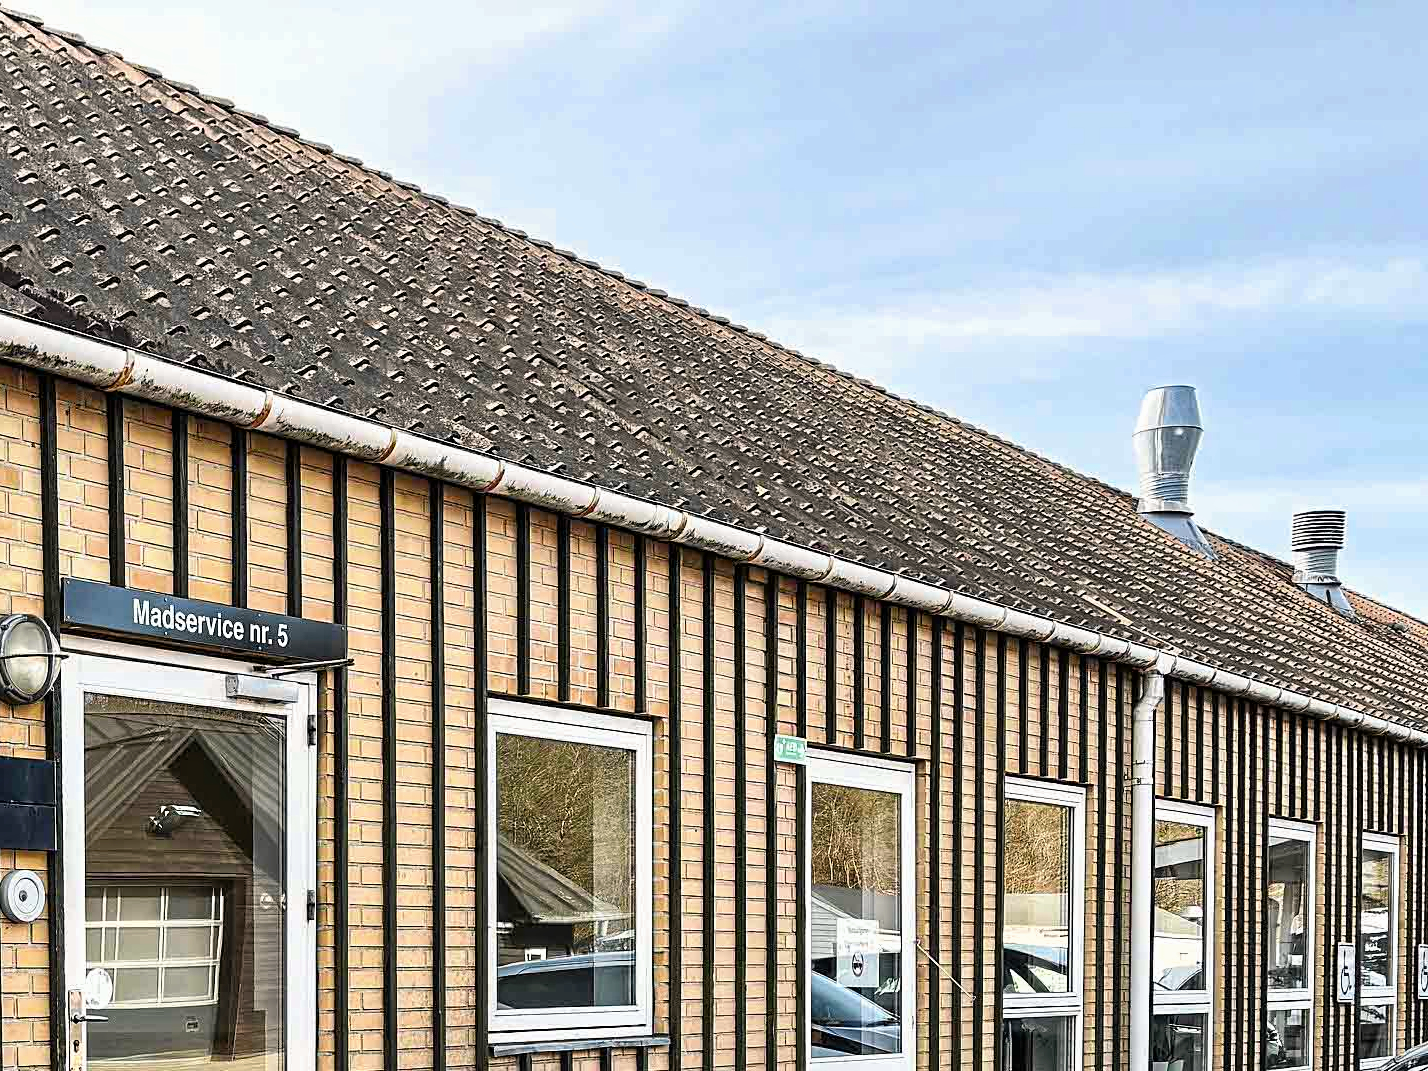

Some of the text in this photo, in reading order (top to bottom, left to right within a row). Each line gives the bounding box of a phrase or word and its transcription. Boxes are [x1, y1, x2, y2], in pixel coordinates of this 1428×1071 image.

[133, 598, 289, 648] Madservice nr. 5
